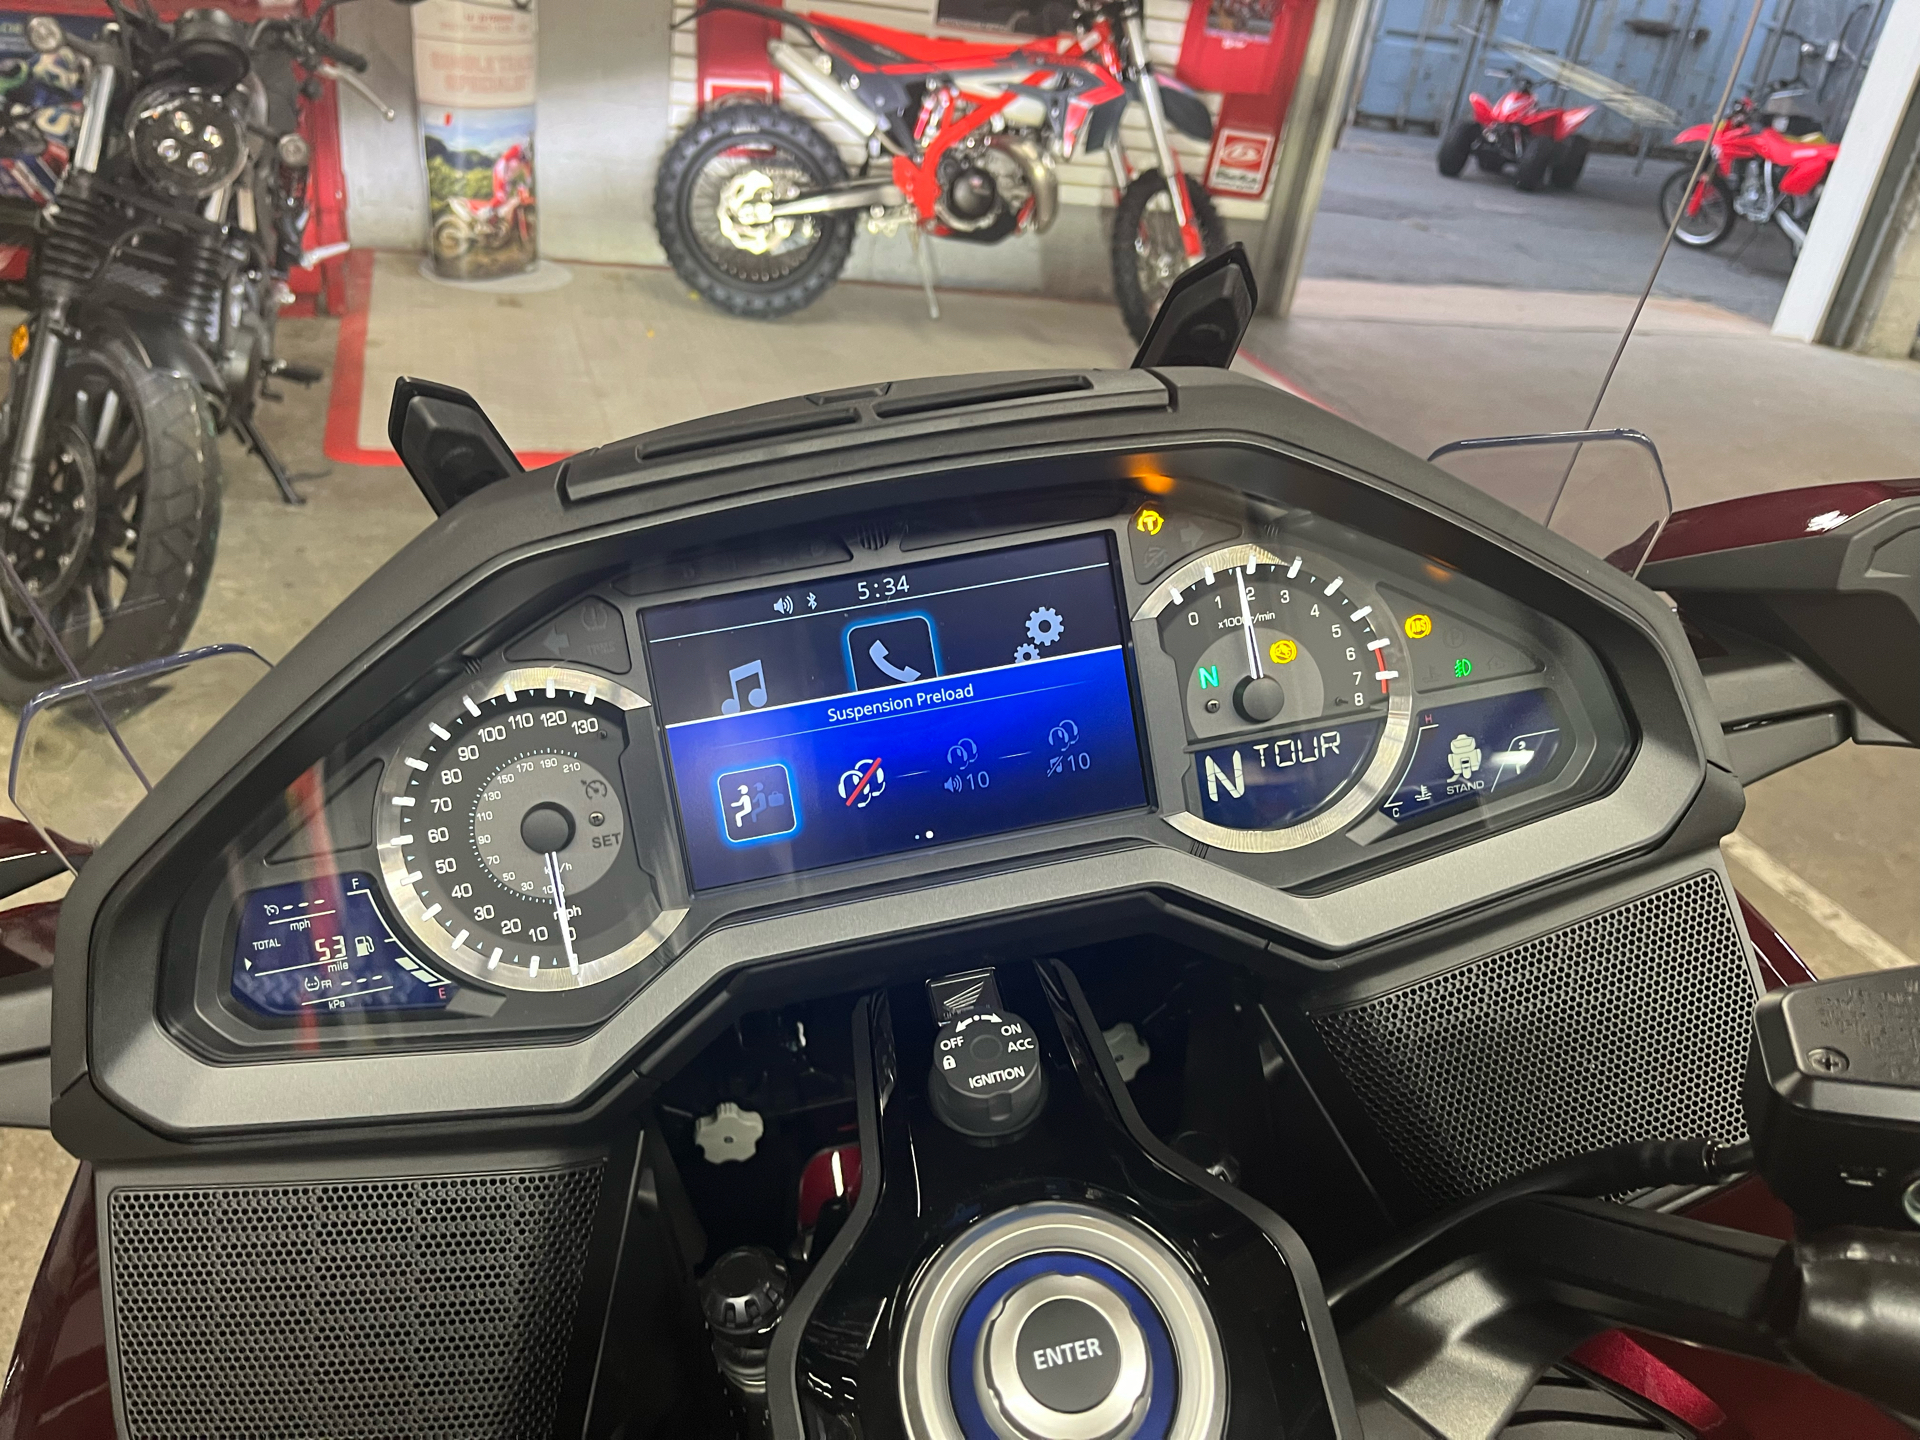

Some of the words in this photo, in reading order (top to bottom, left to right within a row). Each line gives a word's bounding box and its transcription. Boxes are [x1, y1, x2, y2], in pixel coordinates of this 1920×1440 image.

[857, 575, 910, 600] 5:34
[1245, 586, 1256, 601] 2
[1214, 595, 1222, 609] 1
[1280, 589, 1290, 604] 3
[1310, 603, 1320, 618] 4
[1187, 612, 1199, 626] 0
[1331, 624, 1342, 638] 5
[1345, 647, 1356, 661] 6
[1199, 665, 1220, 689] N
[1352, 671, 1362, 686] 7
[827, 697, 913, 722] Suspension
[916, 683, 974, 706] Preload
[1353, 692, 1364, 706] 8
[508, 712, 534, 730] 110
[540, 710, 568, 728] 120
[571, 717, 599, 735] 130
[1424, 713, 1433, 725] H
[478, 725, 507, 743] 100
[457, 744, 480, 762] 90
[1253, 730, 1341, 769] TOUR
[516, 762, 534, 773] 170
[540, 758, 558, 769] 190
[562, 762, 581, 774] 210
[1067, 752, 1091, 772] 10
[441, 768, 463, 785] 80
[496, 774, 515, 785] 150
[966, 770, 990, 791] 10
[1204, 749, 1246, 803] N
[483, 790, 501, 801] 130
[1446, 780, 1485, 796] STAND
[430, 797, 452, 814] 70
[1392, 807, 1401, 818] C
[476, 811, 493, 822] 110
[427, 827, 449, 844] 60
[477, 834, 491, 844] 90
[592, 832, 622, 849] SET
[435, 857, 457, 875] 50
[486, 855, 500, 865] 70
[544, 862, 573, 875] k/h
[351, 878, 360, 890] F
[502, 871, 516, 882] 50
[451, 883, 472, 899] 40
[520, 881, 534, 892] 30
[473, 905, 495, 921] 30
[289, 919, 311, 932] mph
[500, 918, 522, 935] 20
[528, 926, 549, 943] 10
[252, 938, 281, 951] TOTAL
[314, 935, 348, 962] 53
[327, 961, 349, 973] mile
[321, 978, 332, 989] FR
[438, 987, 446, 999] E
[328, 999, 346, 1010] kPa
[1000, 1022, 1022, 1037] ON
[940, 1036, 964, 1051] OFF
[1007, 1038, 1035, 1053] ACC
[968, 1065, 1026, 1089] IGNITION
[1033, 1337, 1103, 1371] ENTER
